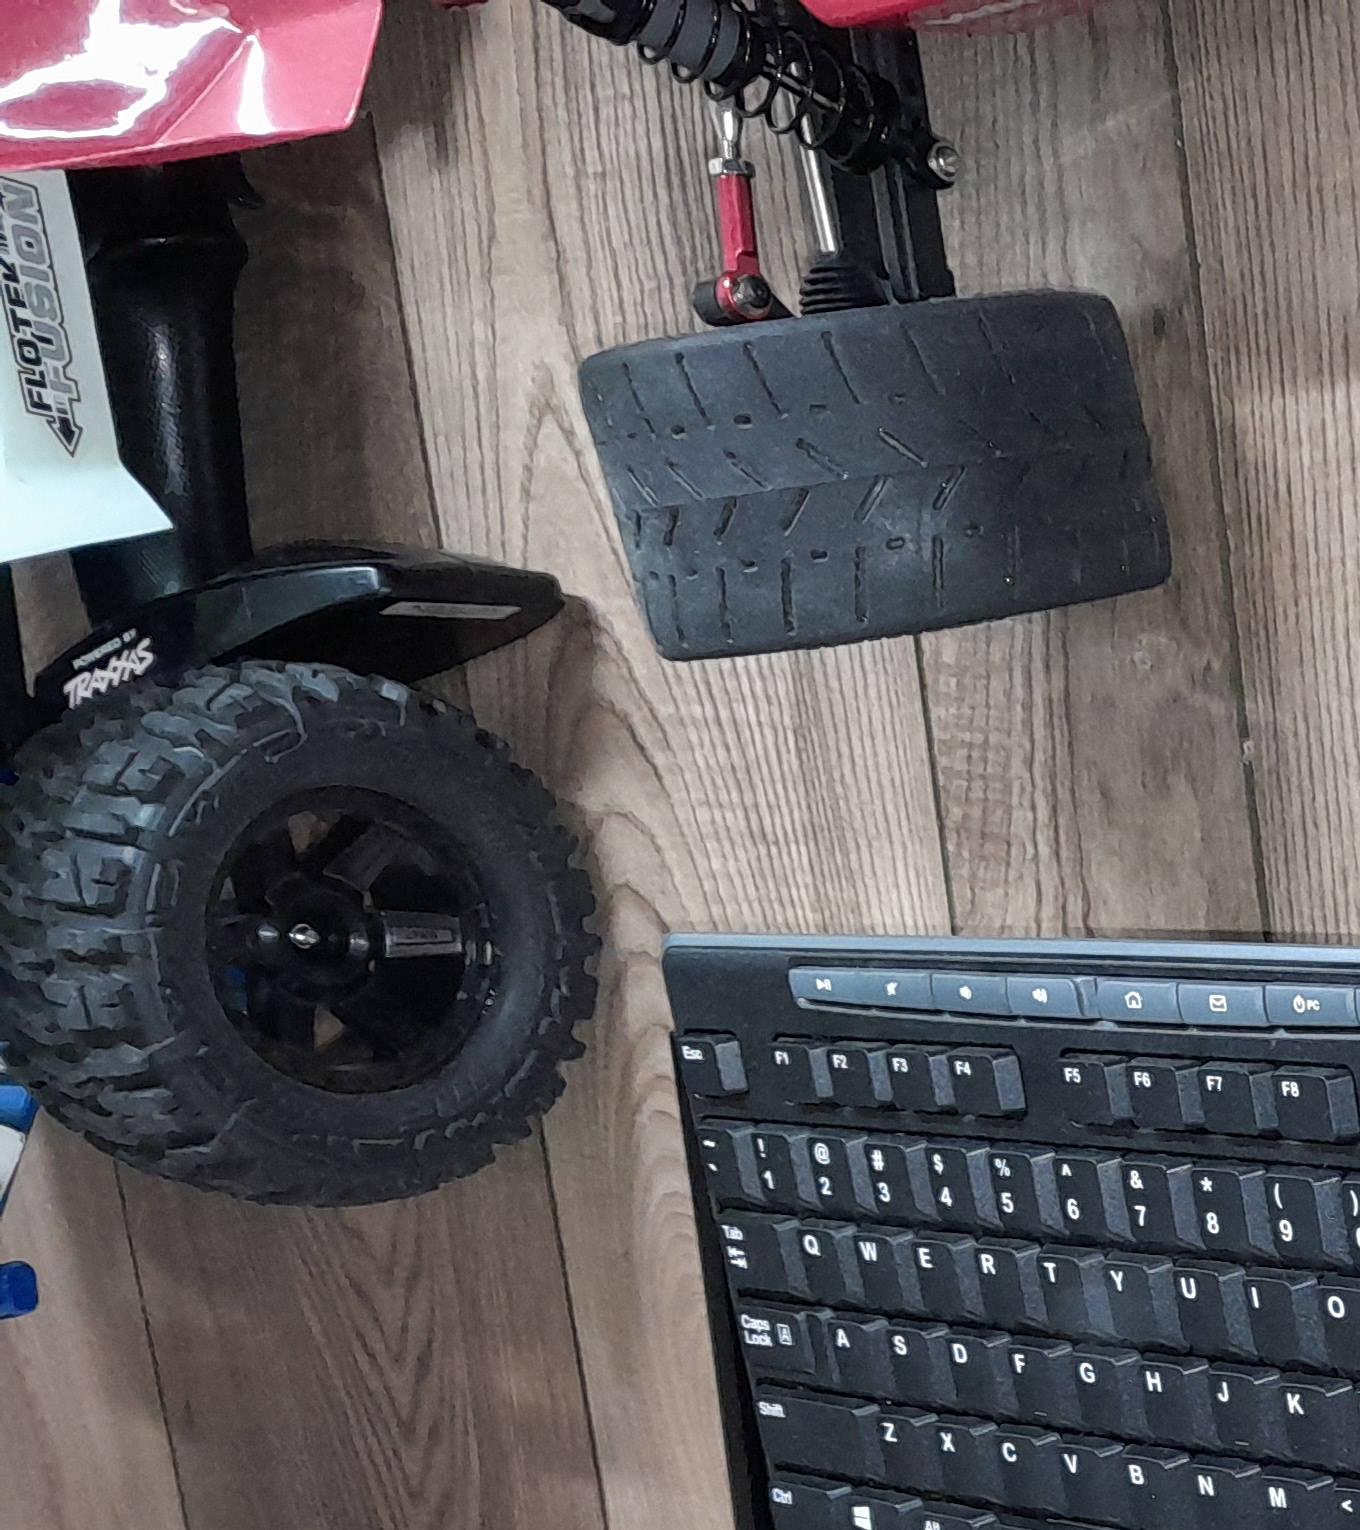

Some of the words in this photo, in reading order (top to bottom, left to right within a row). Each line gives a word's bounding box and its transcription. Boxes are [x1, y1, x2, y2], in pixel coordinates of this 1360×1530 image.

[3, 183, 74, 396] FUSION
[63, 637, 155, 710] TRAXXAS
[774, 1050, 789, 1065] F1
[832, 1054, 849, 1069] F2
[892, 1057, 909, 1073] F3
[954, 1060, 972, 1076] F4
[1063, 1067, 1082, 1083] F5
[1133, 1071, 1152, 1088] F6
[1206, 1075, 1223, 1092] F7
[1281, 1080, 1300, 1098] F8
[763, 1170, 774, 1189] 1
[819, 1176, 833, 1196] 2
[878, 1182, 891, 1203] 3
[940, 1186, 953, 1207] 4
[1000, 1192, 1014, 1213] 5
[1066, 1198, 1080, 1220] 6
[1133, 1205, 1147, 1227] 7
[721, 1224, 744, 1241] Tab
[1206, 1211, 1220, 1234] 8
[1278, 1219, 1293, 1242] 9
[803, 1234, 821, 1256] Q
[858, 1241, 877, 1262] W
[918, 1247, 934, 1269] E
[980, 1253, 996, 1275] R
[1042, 1261, 1057, 1283] T
[1109, 1270, 1124, 1292] Y
[1180, 1277, 1197, 1299] U
[1251, 1286, 1260, 1309] I
[1327, 1295, 1345, 1319] O
[740, 1314, 771, 1334] Caps
[837, 1328, 851, 1348] A
[893, 1335, 908, 1356] S
[952, 1343, 968, 1364] D
[1013, 1353, 1026, 1374] F
[1079, 1362, 1096, 1384] G
[1145, 1370, 1162, 1393] H
[1217, 1381, 1230, 1403] J
[758, 1401, 786, 1418] Shift
[1286, 1392, 1305, 1415] K
[881, 1422, 898, 1443] Z
[940, 1432, 956, 1453] X
[1002, 1442, 1017, 1462] C
[1063, 1453, 1078, 1474] V
[1128, 1464, 1145, 1485] B
[1197, 1474, 1215, 1496] N
[1268, 1486, 1287, 1509] M
